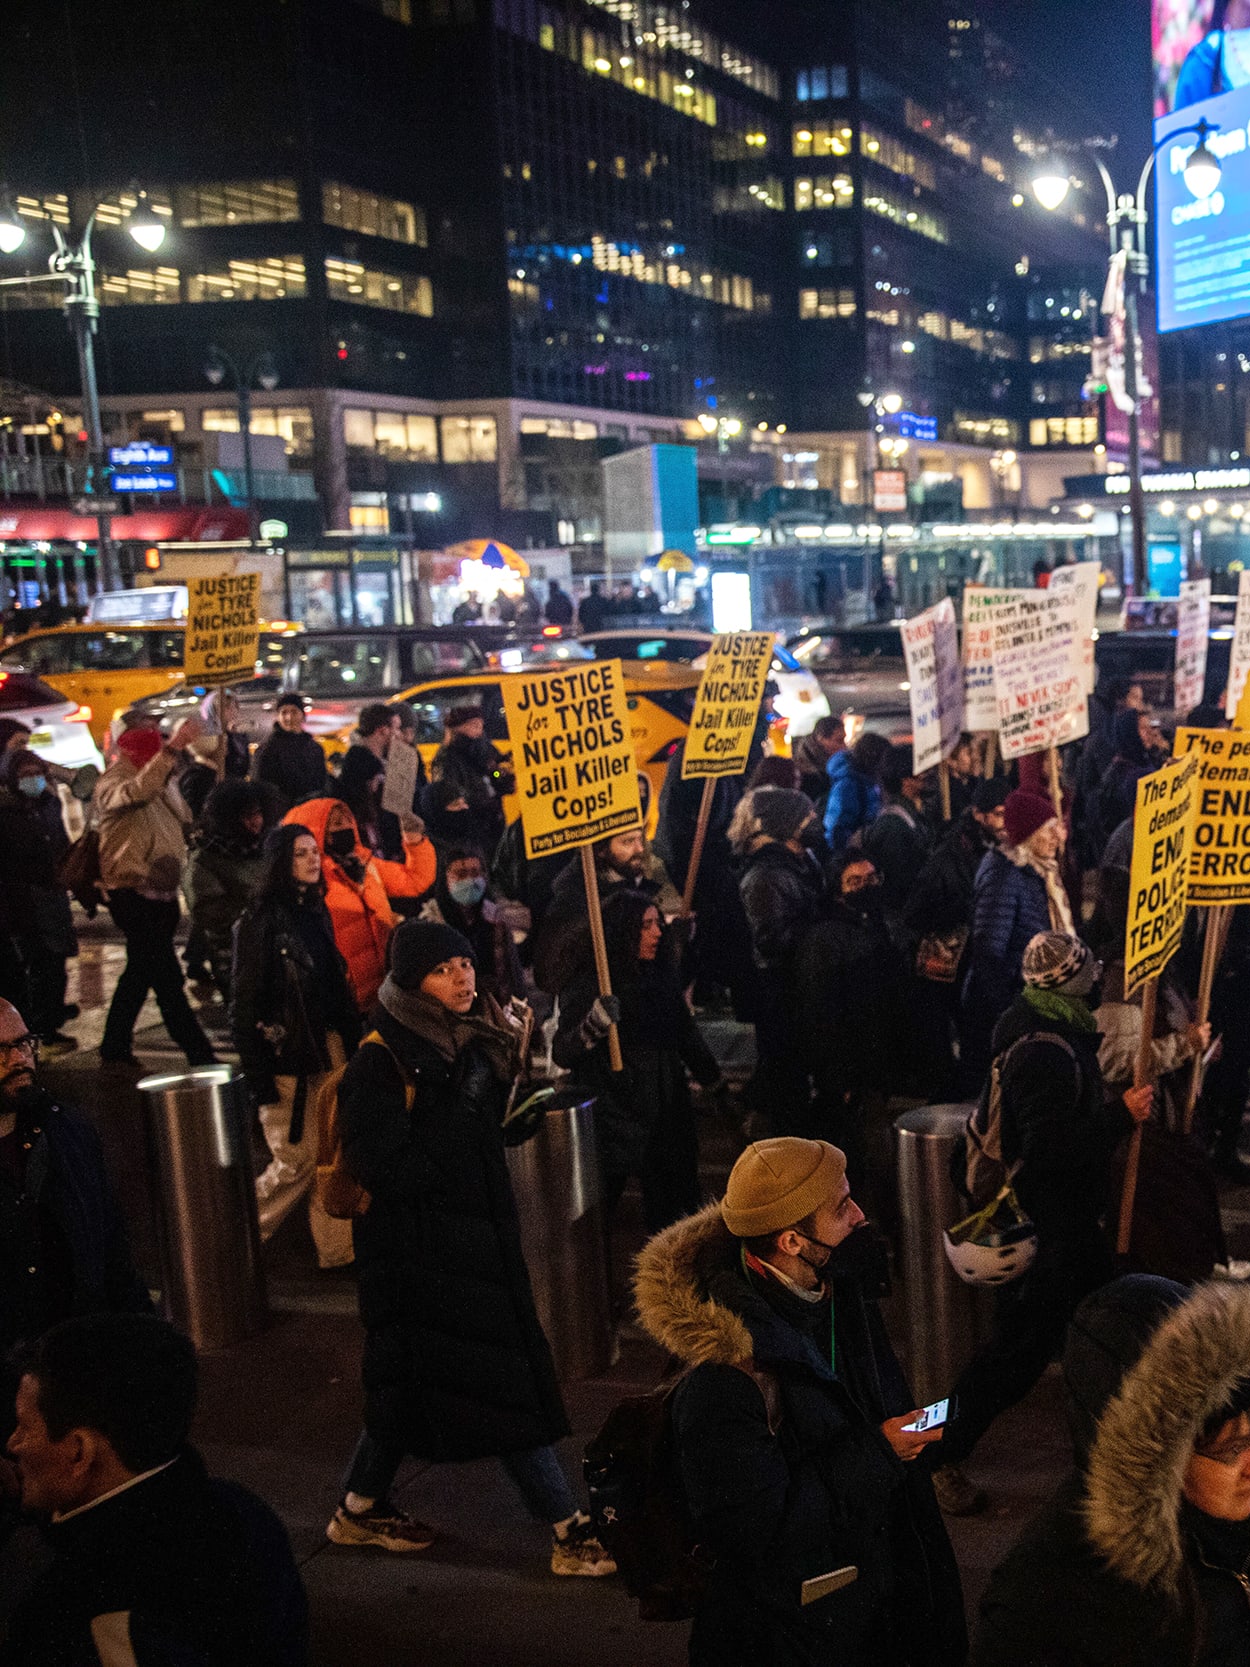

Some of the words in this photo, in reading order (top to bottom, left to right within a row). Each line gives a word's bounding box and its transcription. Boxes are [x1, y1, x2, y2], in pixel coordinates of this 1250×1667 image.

[148, 448, 169, 462] Ave
[195, 574, 257, 596] JUSTICE
[219, 593, 252, 612] TYRE
[193, 610, 256, 632] NICHOLS
[191, 634, 218, 653] Jail
[223, 631, 256, 649] Killer
[714, 635, 769, 657] JUSTICE
[731, 658, 760, 680] TYRE
[517, 666, 614, 711] JUSTICE
[702, 681, 760, 703] NICHOLS
[526, 711, 548, 741] for
[555, 694, 614, 730] TYRE
[696, 708, 723, 730] Jail
[725, 706, 755, 729] Killer
[522, 719, 624, 767] NICHOLS
[704, 732, 741, 758] Cops!
[1185, 734, 1224, 755] The
[526, 766, 568, 798] Jail
[575, 754, 630, 786] Killer
[552, 783, 613, 819] Cops!
[1143, 778, 1167, 806] The
[533, 836, 553, 851] Party
[1151, 825, 1186, 876] END
[1135, 857, 1188, 921] POLICE
[1130, 891, 1185, 958] TERROR
